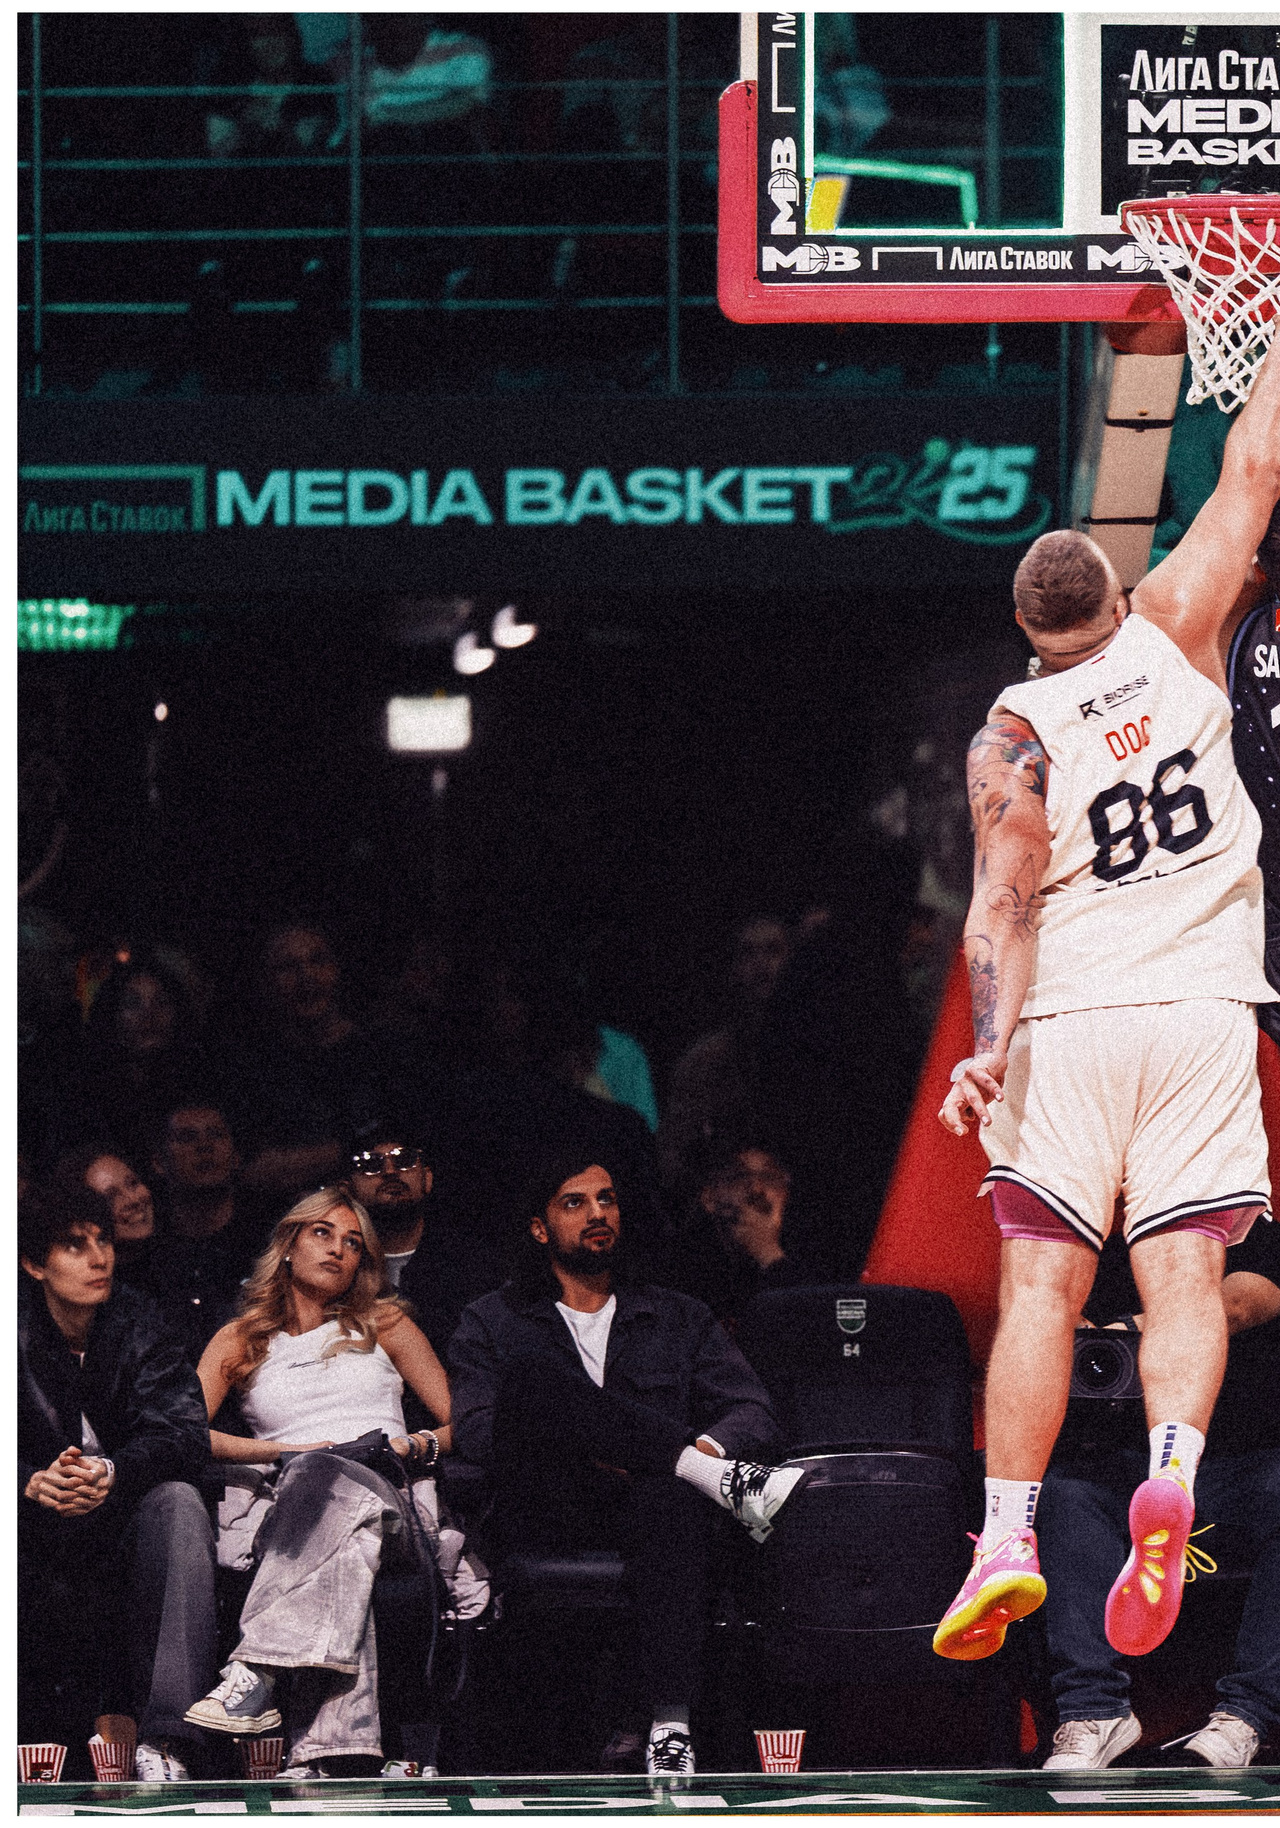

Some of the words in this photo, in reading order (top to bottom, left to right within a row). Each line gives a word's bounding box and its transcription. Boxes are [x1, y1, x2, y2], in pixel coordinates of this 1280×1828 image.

[215, 468, 495, 527] MEDIA
[504, 466, 854, 526] BASKET
[1088, 748, 1214, 883] 86
[843, 1343, 860, 1357] 64
